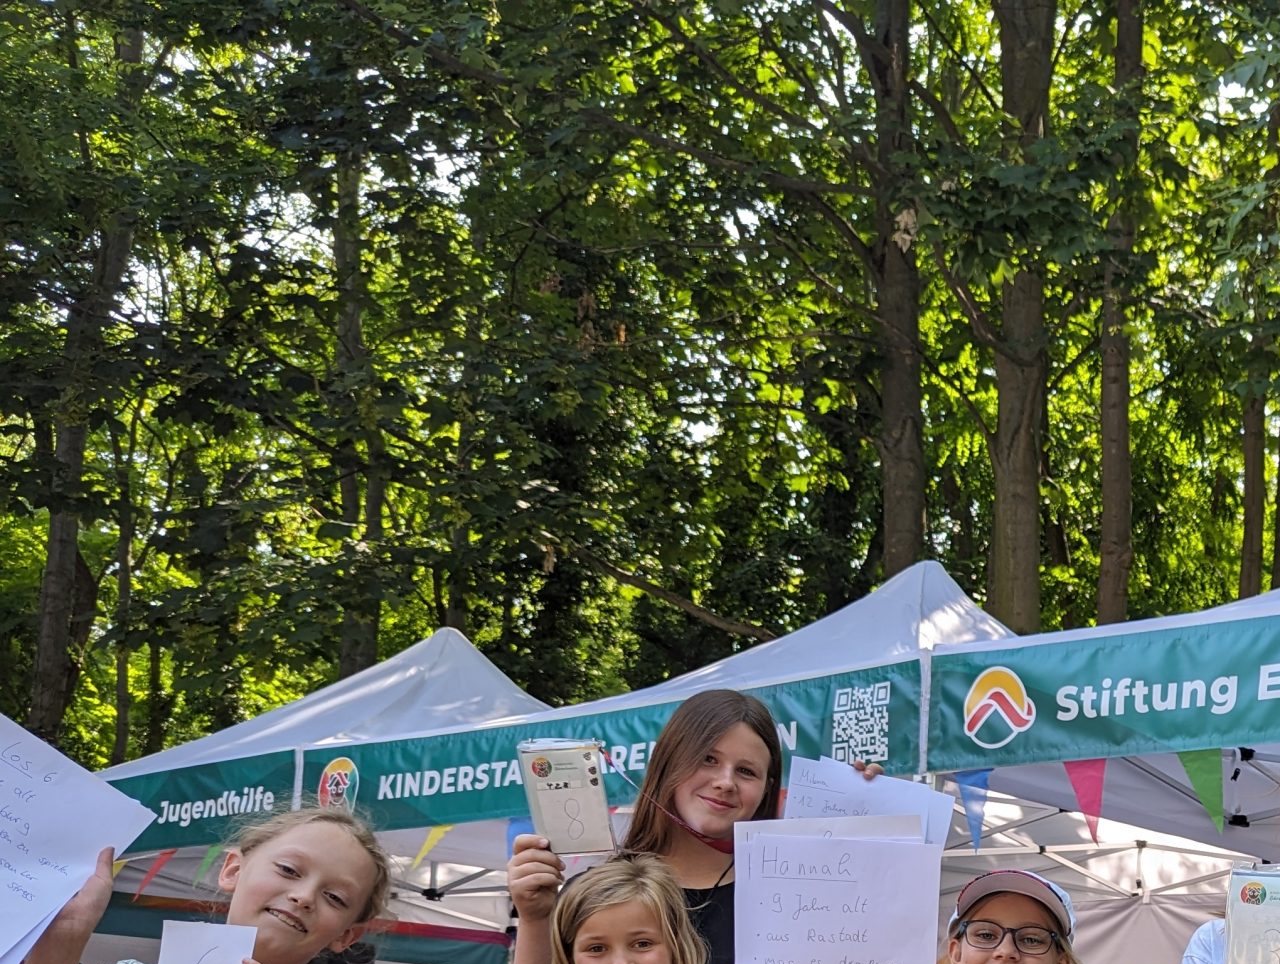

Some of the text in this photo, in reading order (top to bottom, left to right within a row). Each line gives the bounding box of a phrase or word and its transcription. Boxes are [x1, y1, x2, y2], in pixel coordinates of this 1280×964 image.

[1056, 677, 1238, 722] Stiftung
[43, 772, 57, 783] 6
[377, 759, 524, 801] KINDERSTA
[158, 786, 275, 827] Jugendhilfe
[564, 798, 585, 841] 8
[760, 845, 852, 877] Hannah
[771, 894, 869, 921] 9 Jahre alt
[766, 928, 869, 944] aus Rastadt
